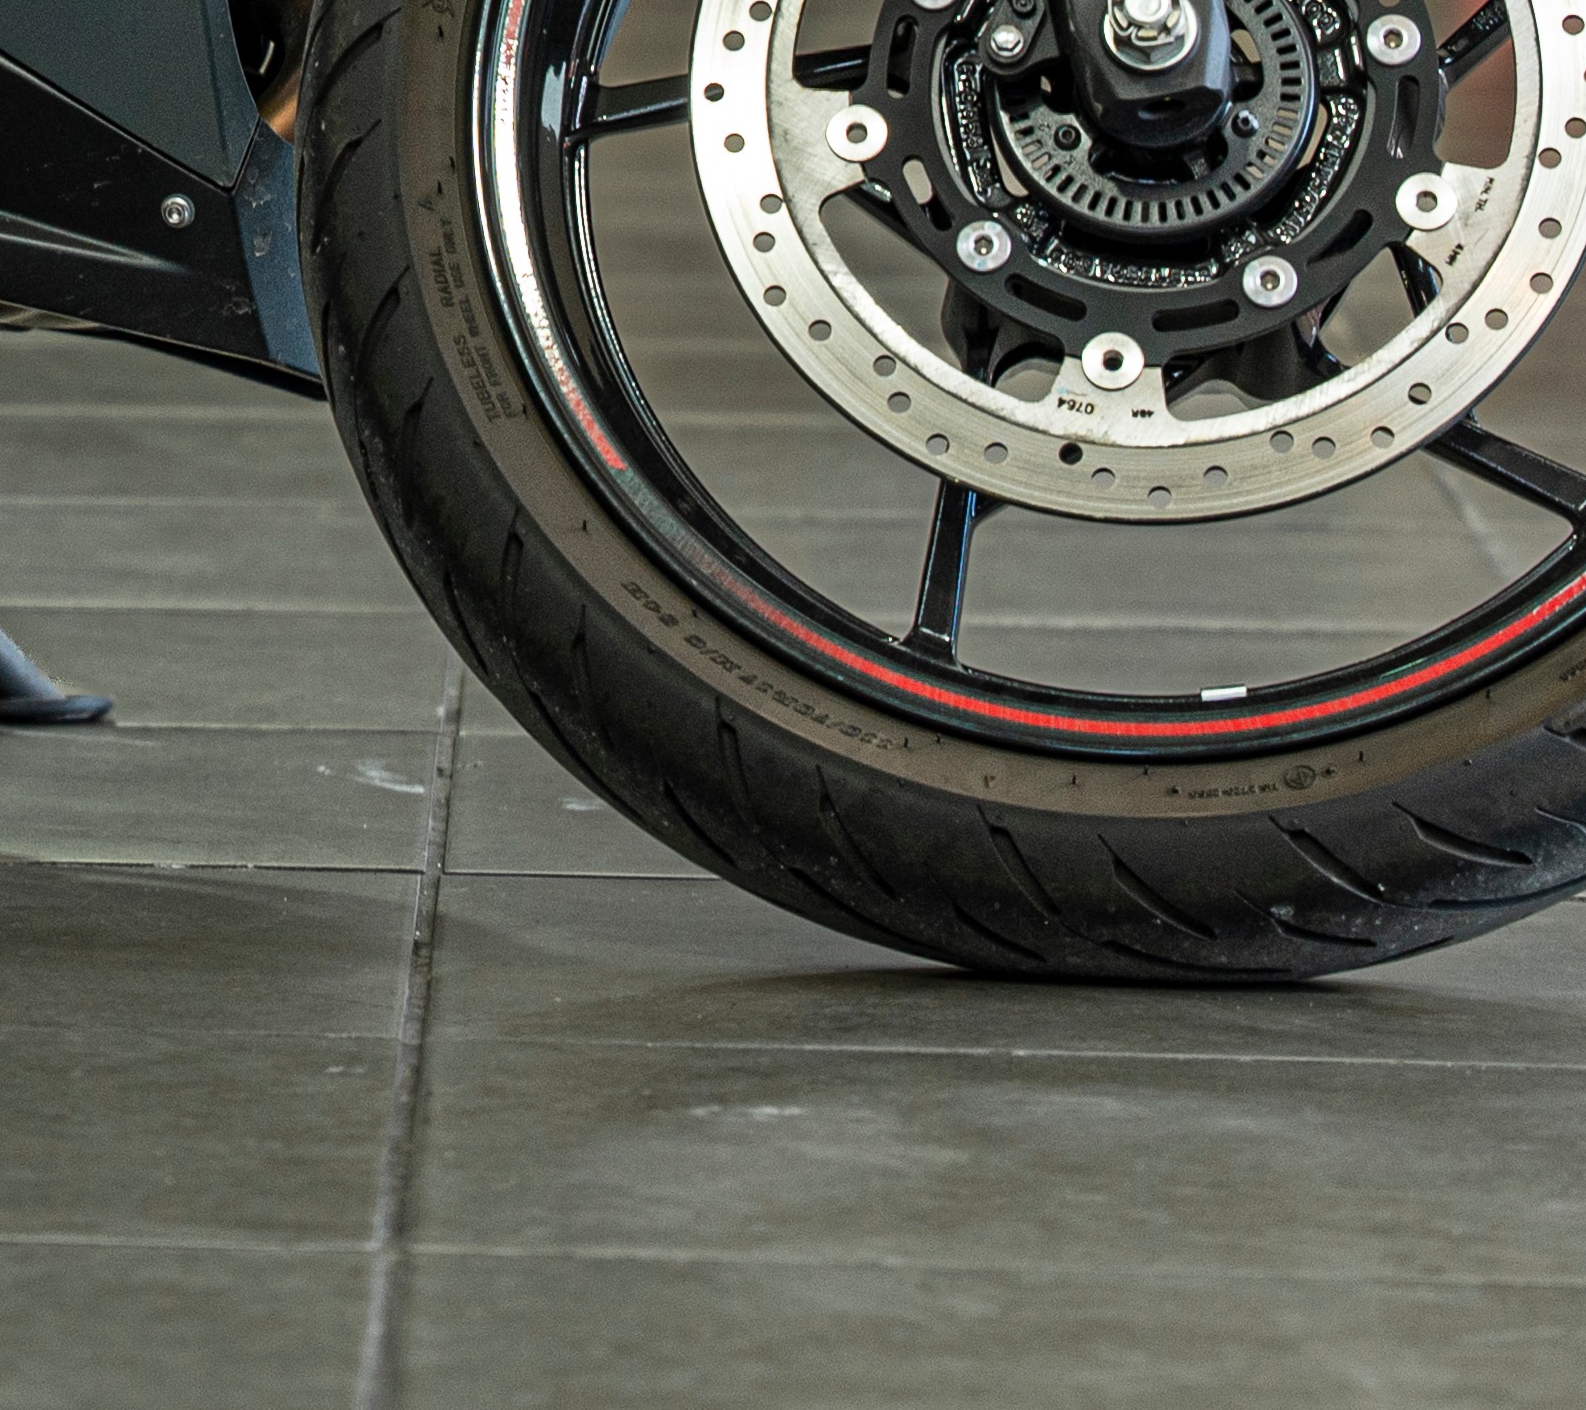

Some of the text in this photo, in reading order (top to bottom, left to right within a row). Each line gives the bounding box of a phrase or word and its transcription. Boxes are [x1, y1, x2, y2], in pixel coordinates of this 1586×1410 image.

[429, 245, 499, 424] TUBELESS RADIAL
[1057, 397, 1095, 415] 0764
